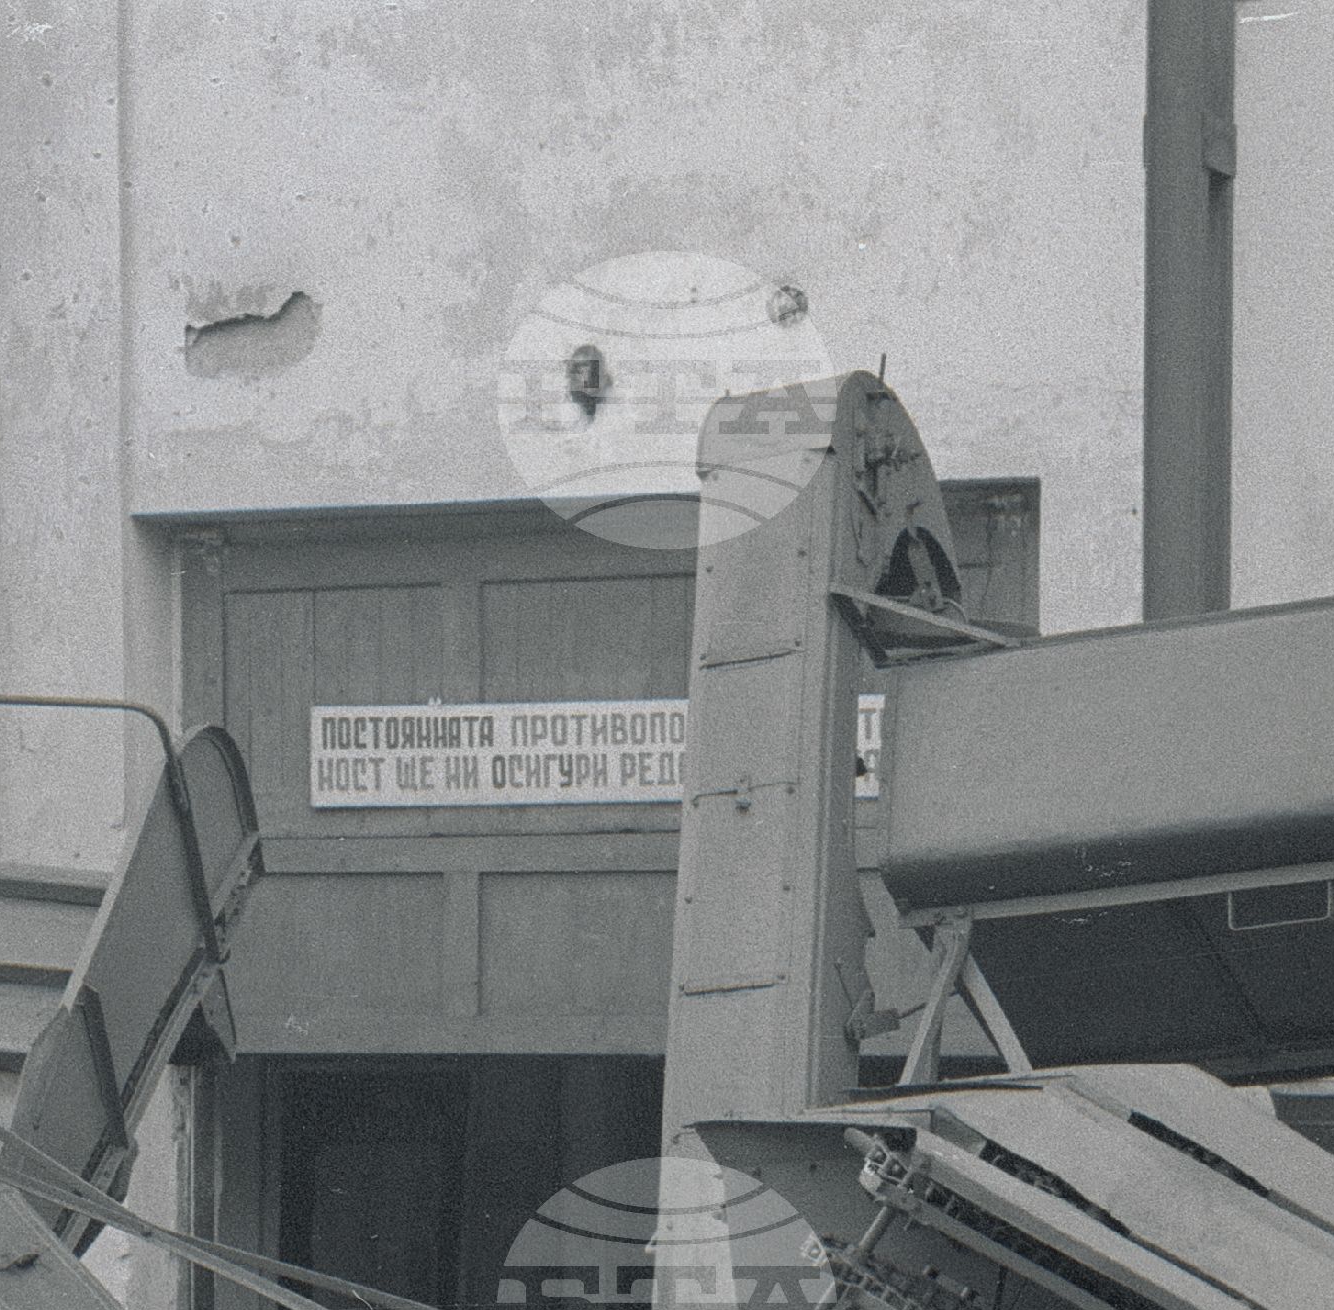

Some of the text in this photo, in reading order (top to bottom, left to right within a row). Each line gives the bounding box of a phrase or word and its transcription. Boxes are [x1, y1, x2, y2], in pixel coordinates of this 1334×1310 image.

[321, 711, 686, 750] ПОСТОЯННАТА ПРОТИВОПО
[317, 750, 686, 792] НОСТ ЩЕ НИ ОСИГУРИ РЕД
